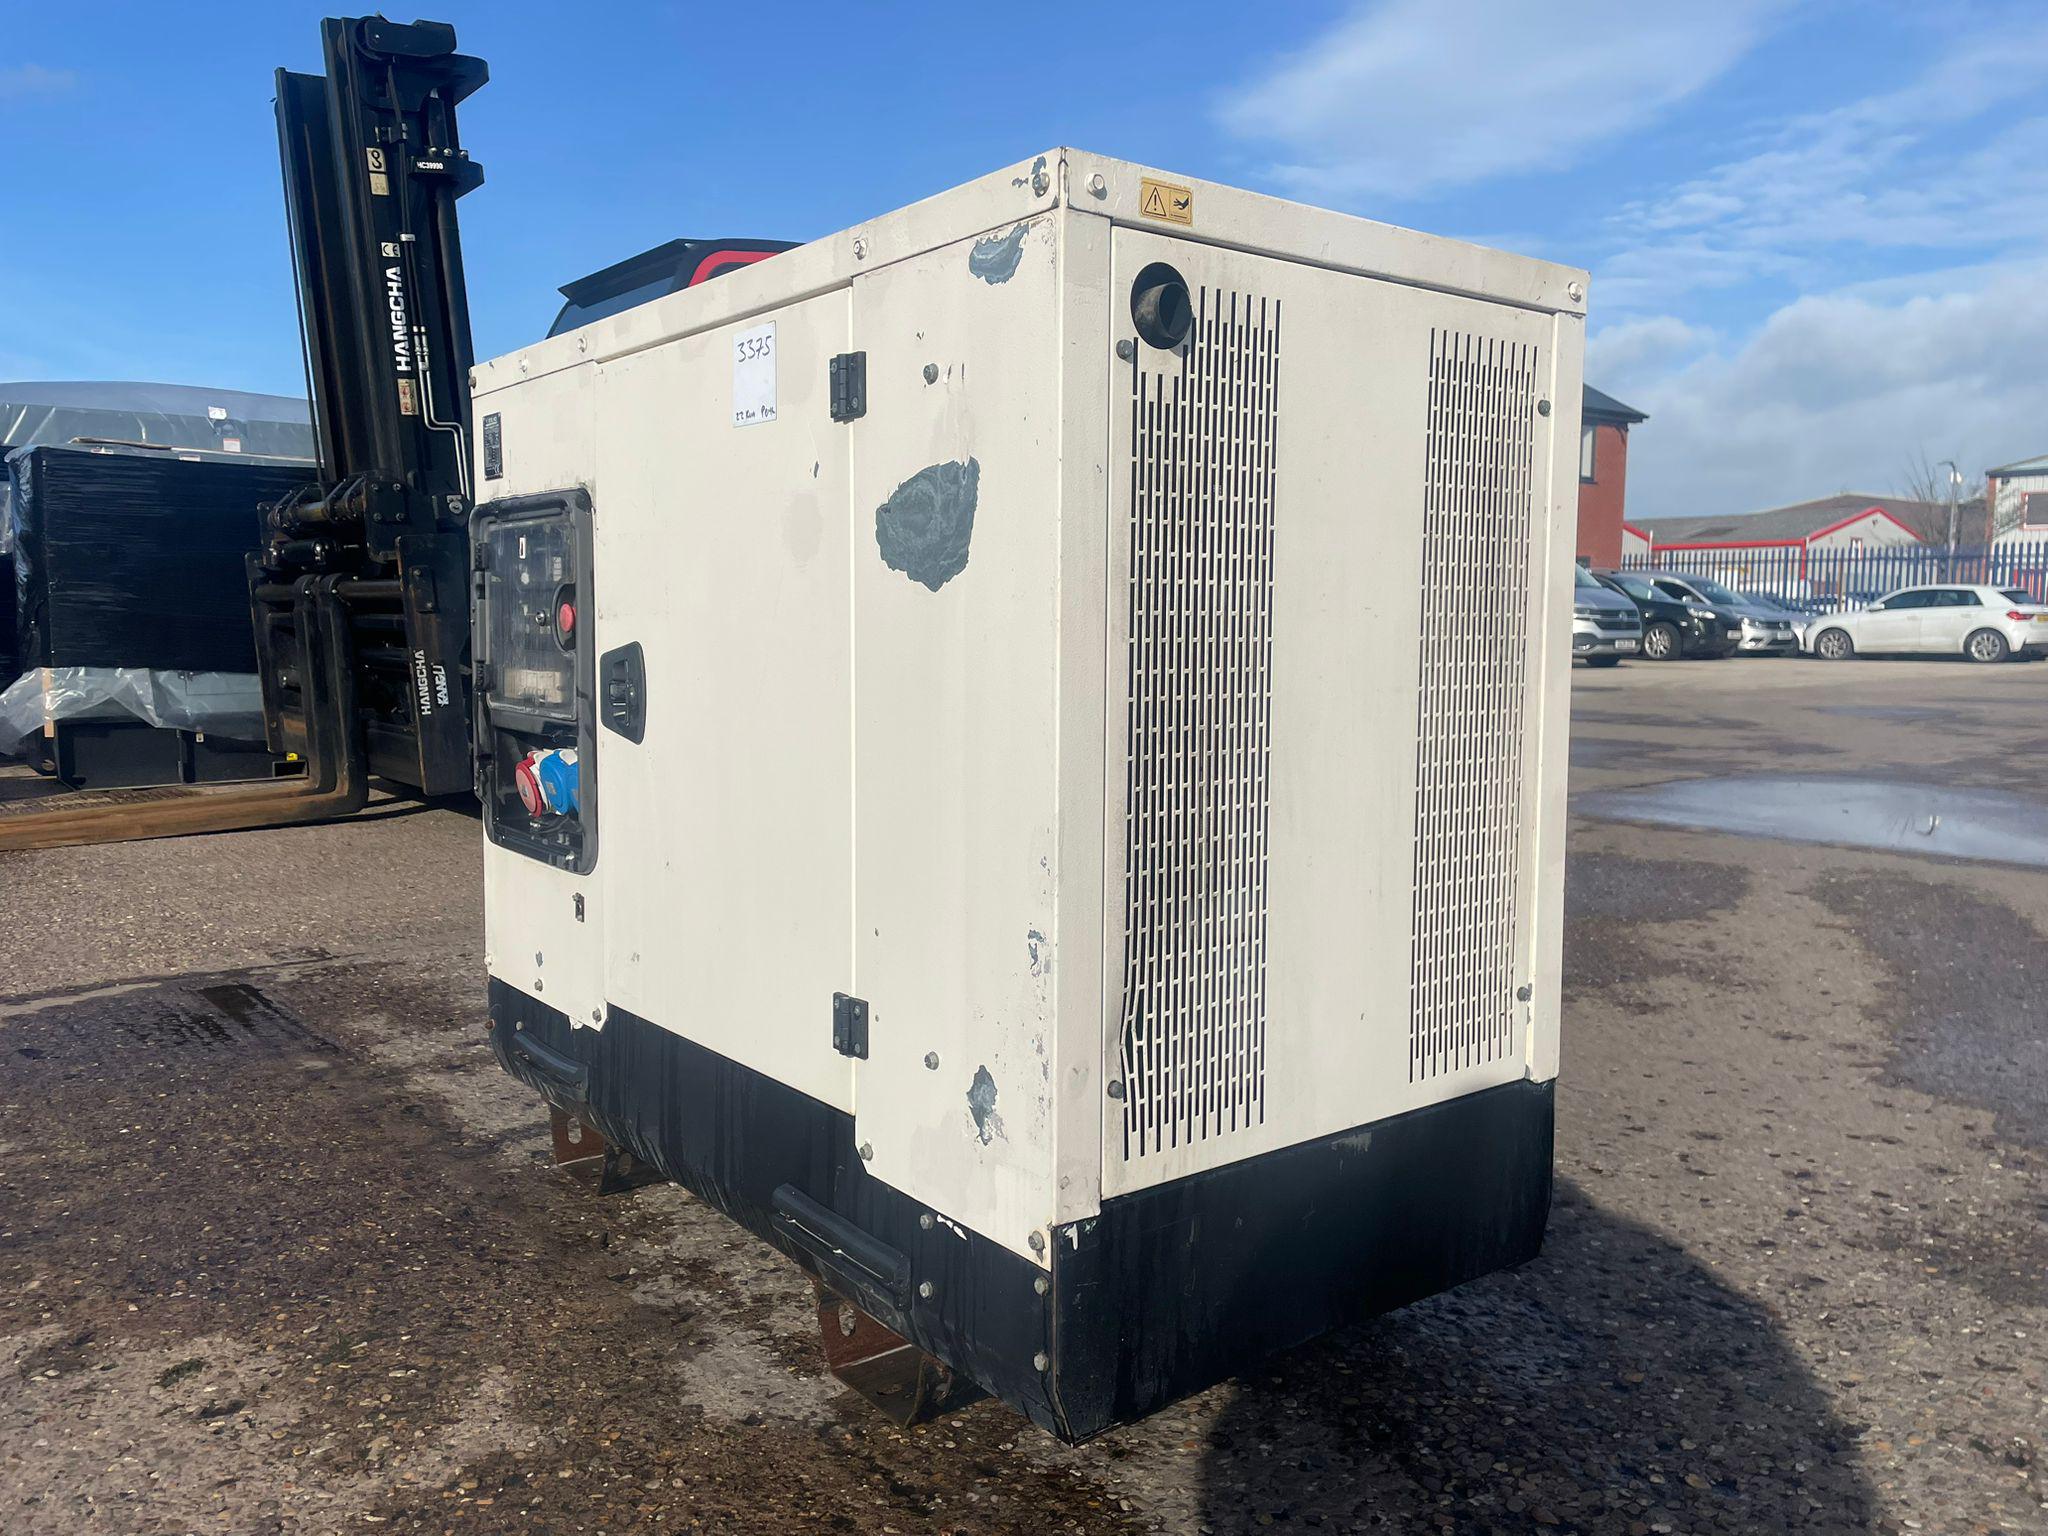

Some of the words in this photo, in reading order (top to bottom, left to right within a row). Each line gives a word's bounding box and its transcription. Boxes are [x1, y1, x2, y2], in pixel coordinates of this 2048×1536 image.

[385, 266, 412, 371] HANGCHA
[737, 335, 772, 363] 3375
[414, 650, 432, 715] HANGCHA
